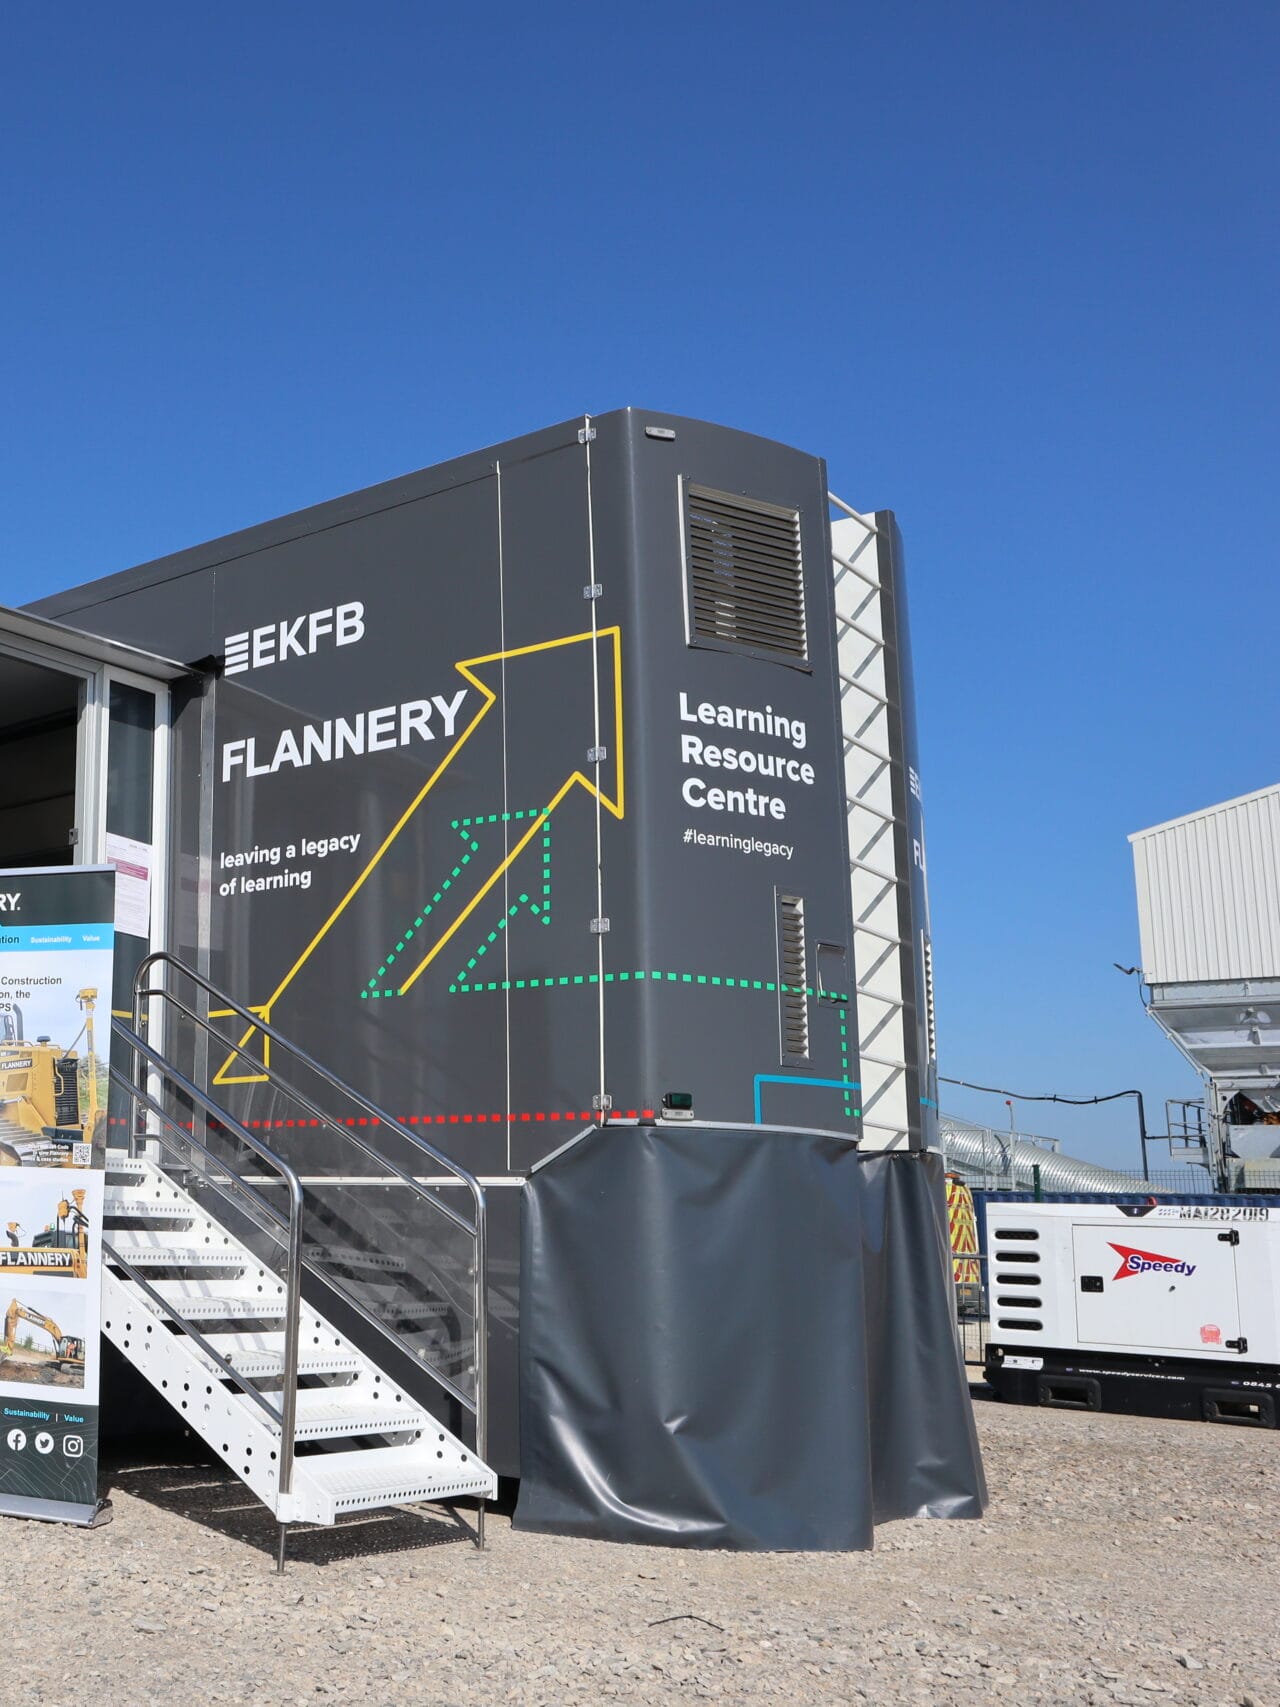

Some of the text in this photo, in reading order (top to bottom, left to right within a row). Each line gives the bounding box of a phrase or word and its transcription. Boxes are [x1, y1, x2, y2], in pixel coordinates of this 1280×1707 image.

[252, 602, 365, 669] EKFB
[679, 692, 807, 749] Learning
[222, 690, 468, 783] FLANNERY
[681, 734, 816, 785] Resource
[682, 777, 787, 820] Centre
[220, 833, 361, 869] leaving a legacy
[683, 828, 794, 860] #learninglegacy
[220, 869, 312, 897] of learning
[30, 935, 72, 944] Sustainability
[82, 934, 100, 942] Value
[1, 975, 62, 986] Construction
[15, 990, 30, 998] the
[1, 1059, 32, 1069] FLANNERY
[1128, 1255, 1197, 1276] Speedy
[3, 1407, 50, 1421] Sustainability
[64, 1414, 84, 1423] Value
